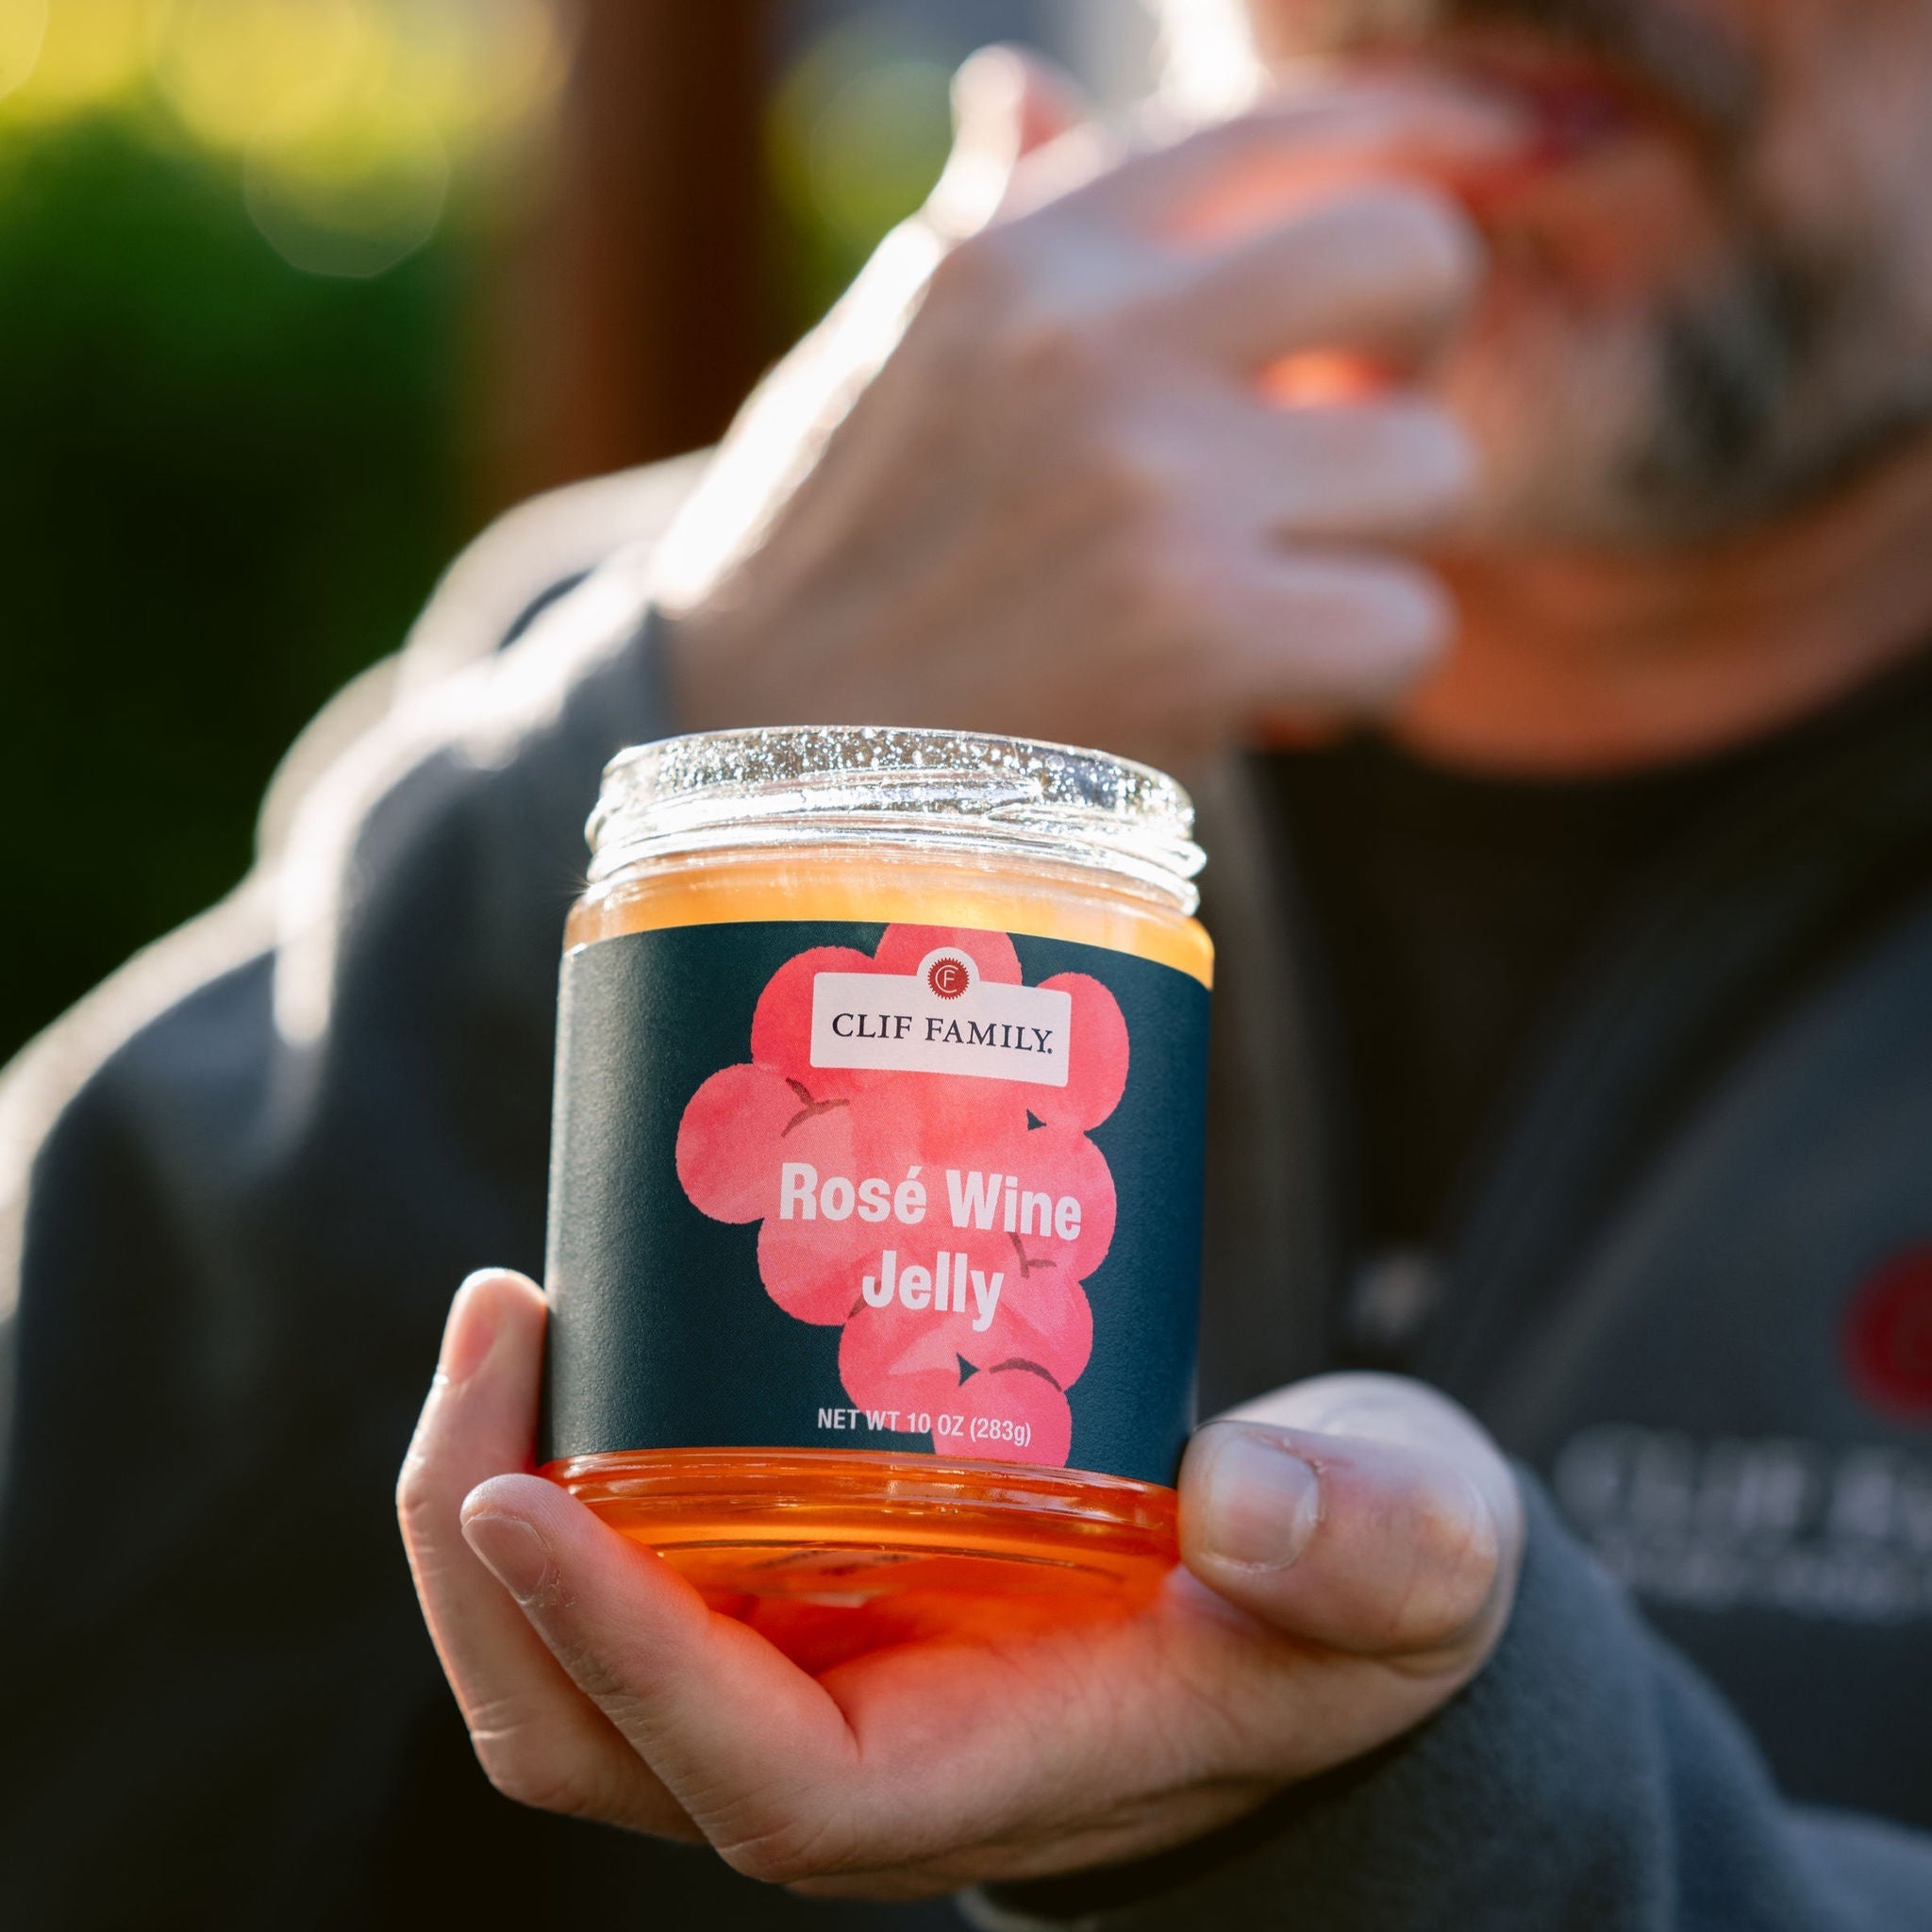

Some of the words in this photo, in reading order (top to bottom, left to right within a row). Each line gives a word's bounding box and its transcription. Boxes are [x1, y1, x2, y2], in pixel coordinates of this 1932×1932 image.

[832, 1013, 912, 1039] CLIF
[780, 1162, 926, 1224] Rosé
[946, 1170, 1082, 1241] Wine
[862, 1250, 1004, 1332] Jelly
[818, 1408, 860, 1429] NET
[865, 1409, 900, 1431] WT
[908, 1412, 931, 1433] 10
[938, 1414, 964, 1436] OZ
[970, 1417, 1031, 1446] (283g)
